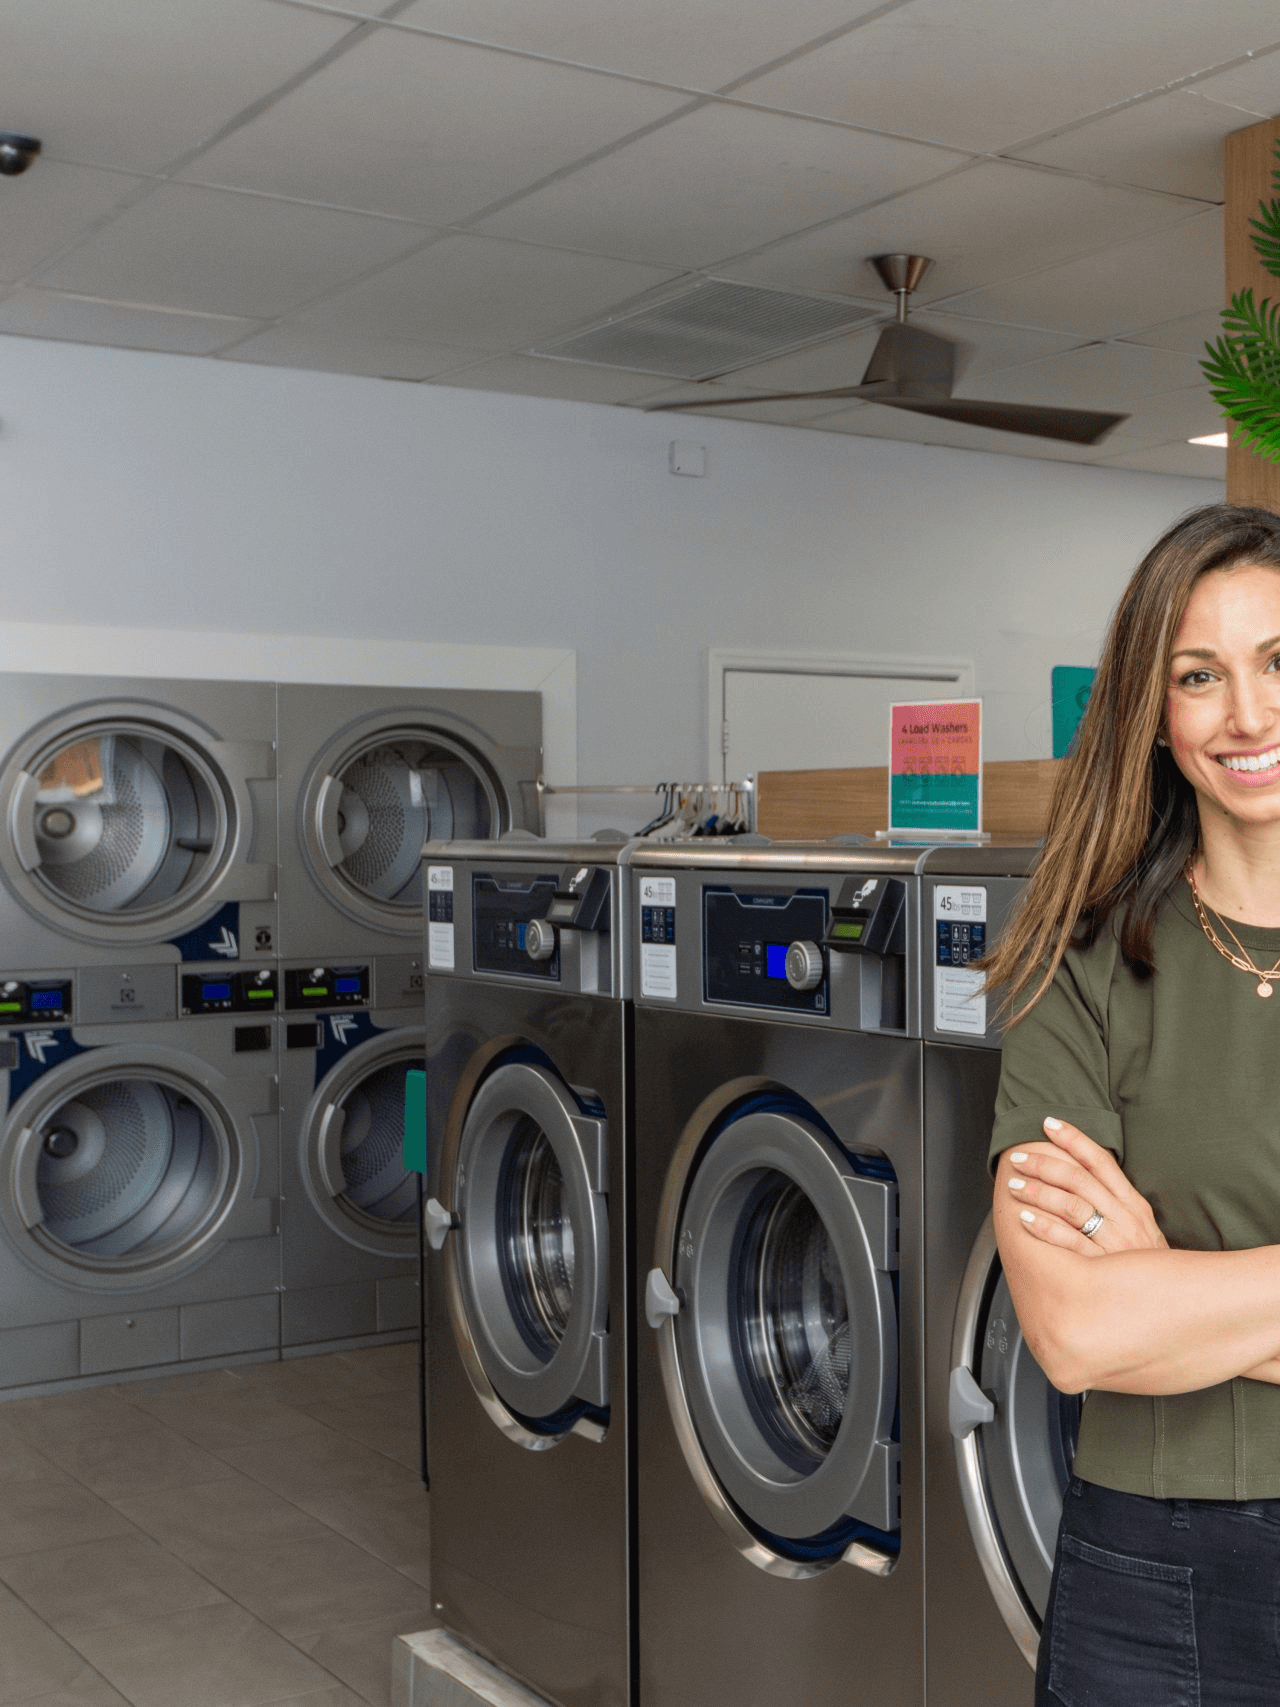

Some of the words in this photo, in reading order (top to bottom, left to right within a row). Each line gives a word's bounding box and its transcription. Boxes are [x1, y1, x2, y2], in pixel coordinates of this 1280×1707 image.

[901, 723, 908, 734] 4
[909, 723, 929, 735] Load
[931, 722, 968, 733] Washers
[940, 896, 952, 911] 45
